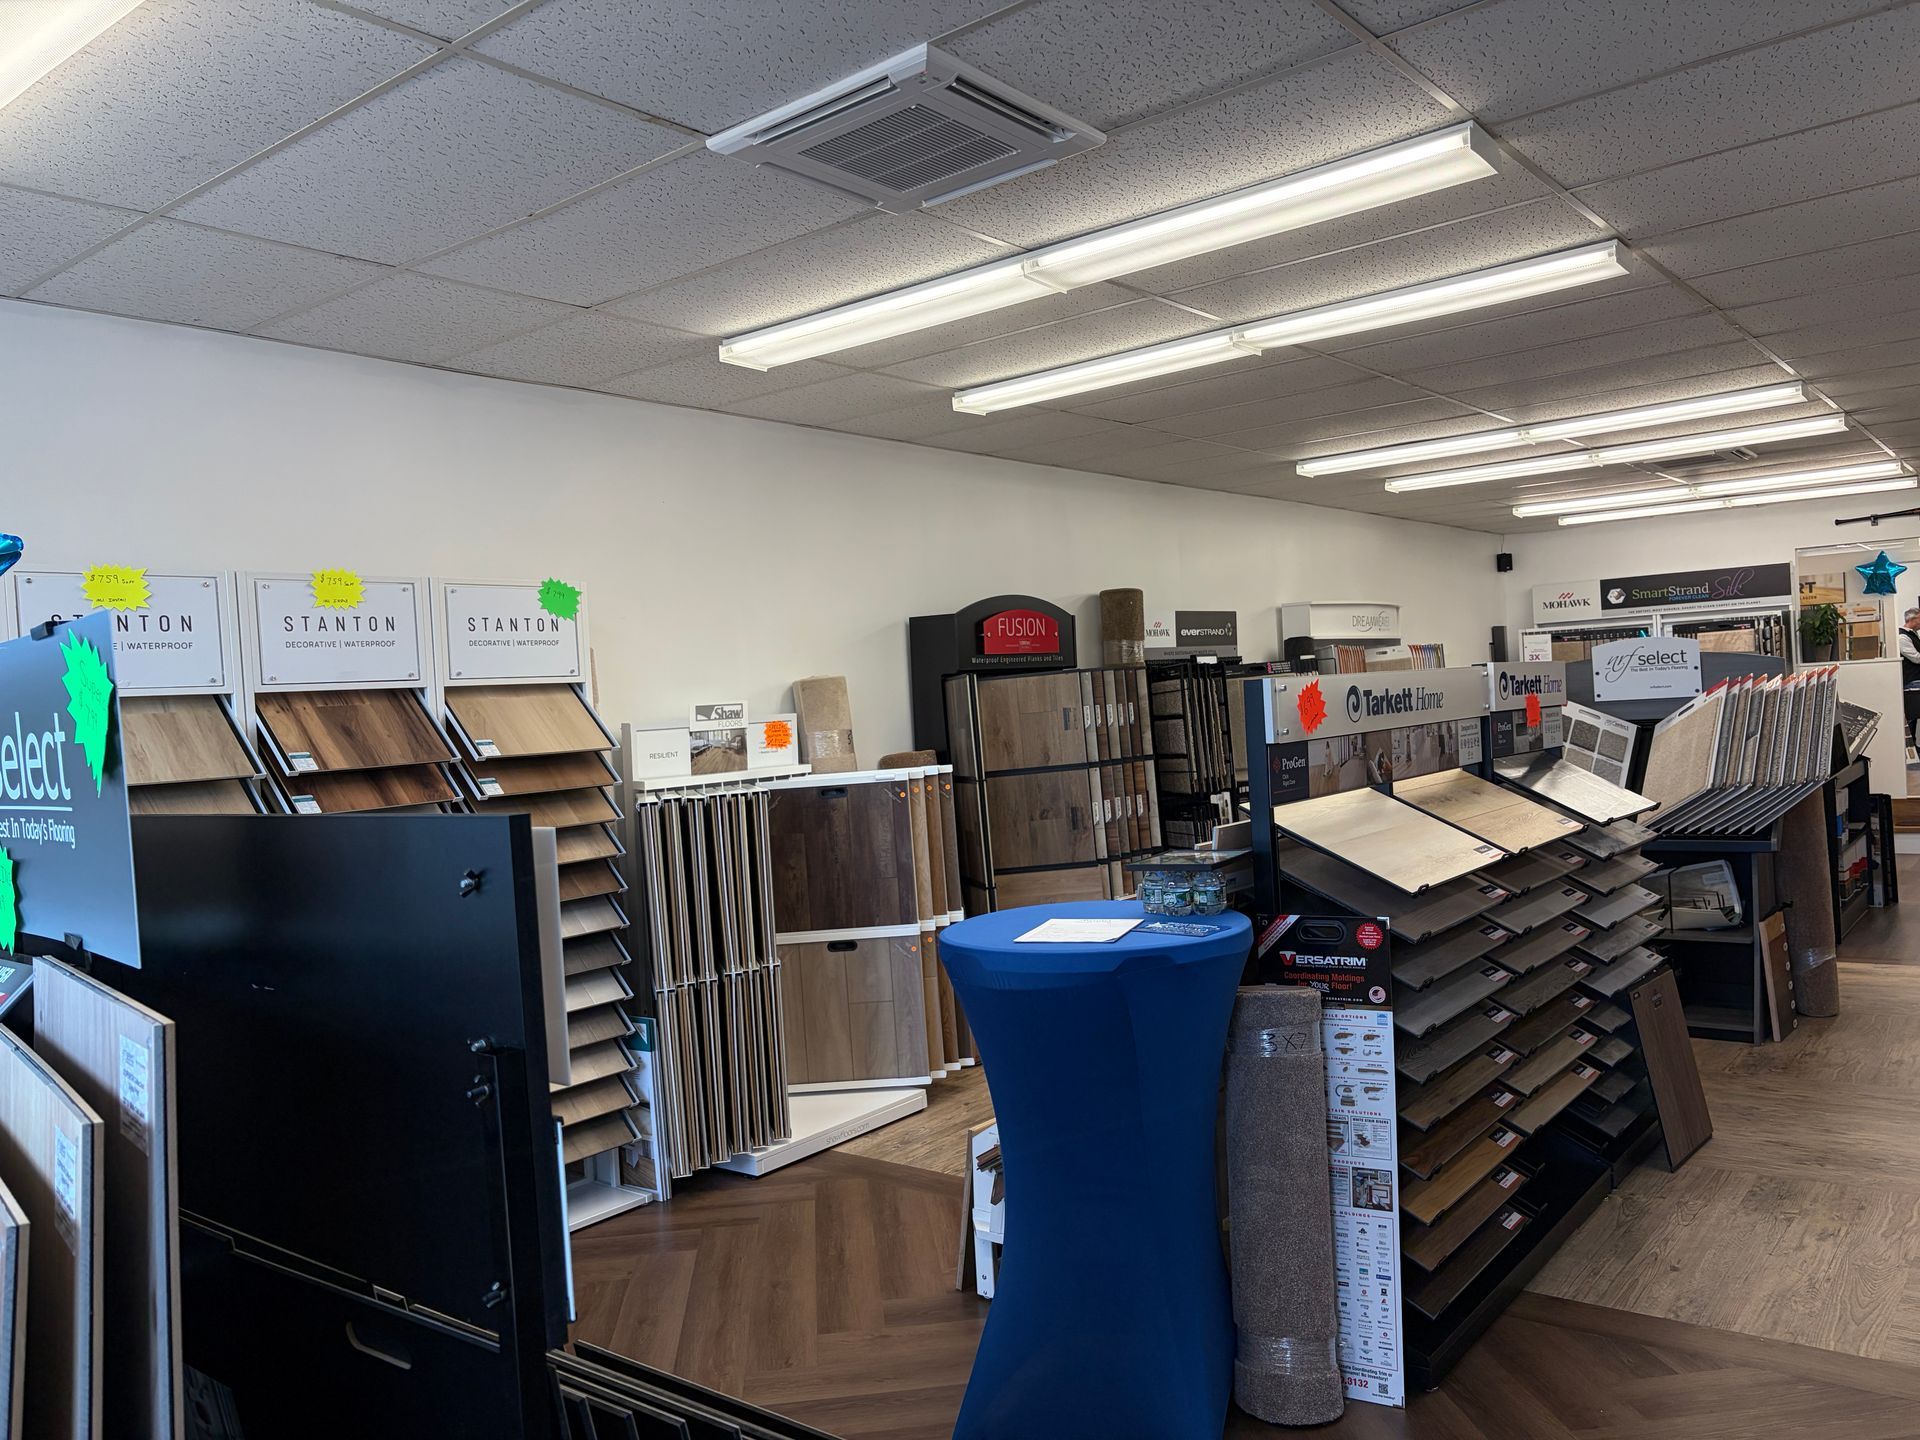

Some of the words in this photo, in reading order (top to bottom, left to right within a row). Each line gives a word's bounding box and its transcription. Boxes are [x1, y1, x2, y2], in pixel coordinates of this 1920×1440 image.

[1632, 582, 1709, 600] SmartStrand
[1712, 568, 1755, 598] Silk
[1543, 598, 1590, 610] MOHAWK
[284, 616, 395, 632] STANTON
[467, 617, 559, 632] STANTON
[998, 618, 1046, 637] FUSION
[1146, 629, 1170, 637] MOHAWK
[1180, 628, 1225, 636] everSTRAND
[127, 641, 193, 649] WATERPROOF
[285, 641, 337, 649] DECORATIVE
[344, 640, 396, 648] WATERPROOF
[516, 639, 559, 647] WATERPROOF
[1638, 650, 1688, 666] select
[1510, 675, 1541, 696] Tarkett
[1543, 675, 1562, 694] Home
[1363, 687, 1413, 716] Tarkett
[1416, 687, 1444, 712] Home
[714, 707, 742, 719] Shaw
[718, 720, 743, 728] FLOORS
[0, 711, 72, 800] elect
[649, 752, 678, 760] RESILIENT
[1282, 756, 1306, 770] ProGen
[10, 818, 20, 838] In
[20, 817, 48, 845] Today's
[48, 818, 76, 850] Flooring
[1279, 951, 1366, 967] VERSATRIM
[1284, 971, 1330, 981] Coordinating
[1331, 973, 1365, 983] Moldings
[1331, 982, 1352, 990] Floor!
